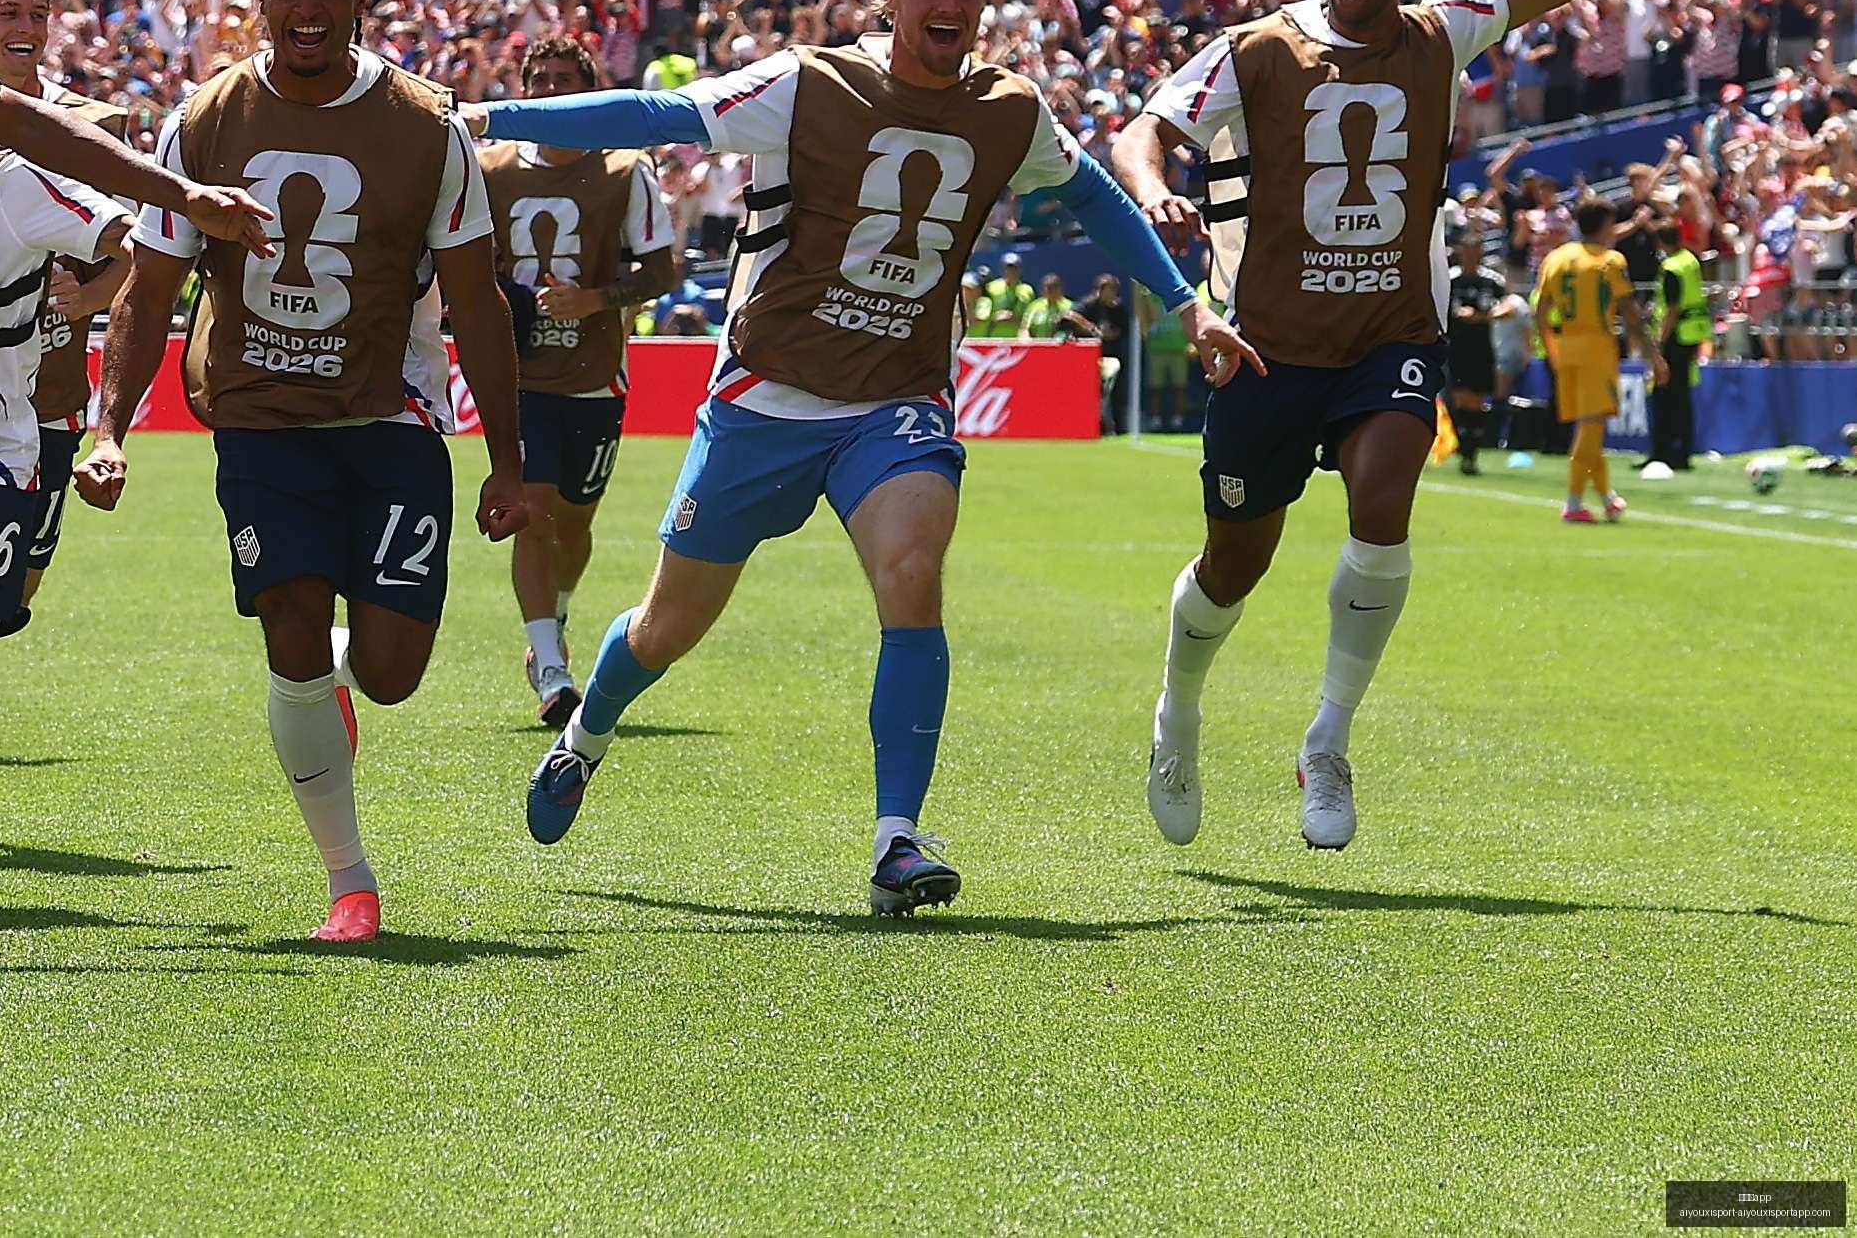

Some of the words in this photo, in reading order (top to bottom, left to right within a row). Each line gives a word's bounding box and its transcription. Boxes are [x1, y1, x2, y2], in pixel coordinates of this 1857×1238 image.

[1335, 214, 1382, 232] FIFA
[869, 260, 915, 284] FIFA
[1302, 251, 1369, 267] WORLD
[1372, 251, 1403, 265] CUP
[1301, 268, 1402, 294] 2026
[1562, 272, 1577, 318] 5
[270, 291, 319, 313] FIFA
[825, 287, 891, 312] WORLD
[893, 303, 925, 317] CUP
[811, 303, 913, 339] 2026
[244, 322, 304, 351] WORLD
[308, 336, 347, 351] CUP
[242, 342, 344, 377] 2026
[1401, 358, 1426, 387] 6
[586, 440, 617, 481] 10
[373, 504, 438, 576] 12
